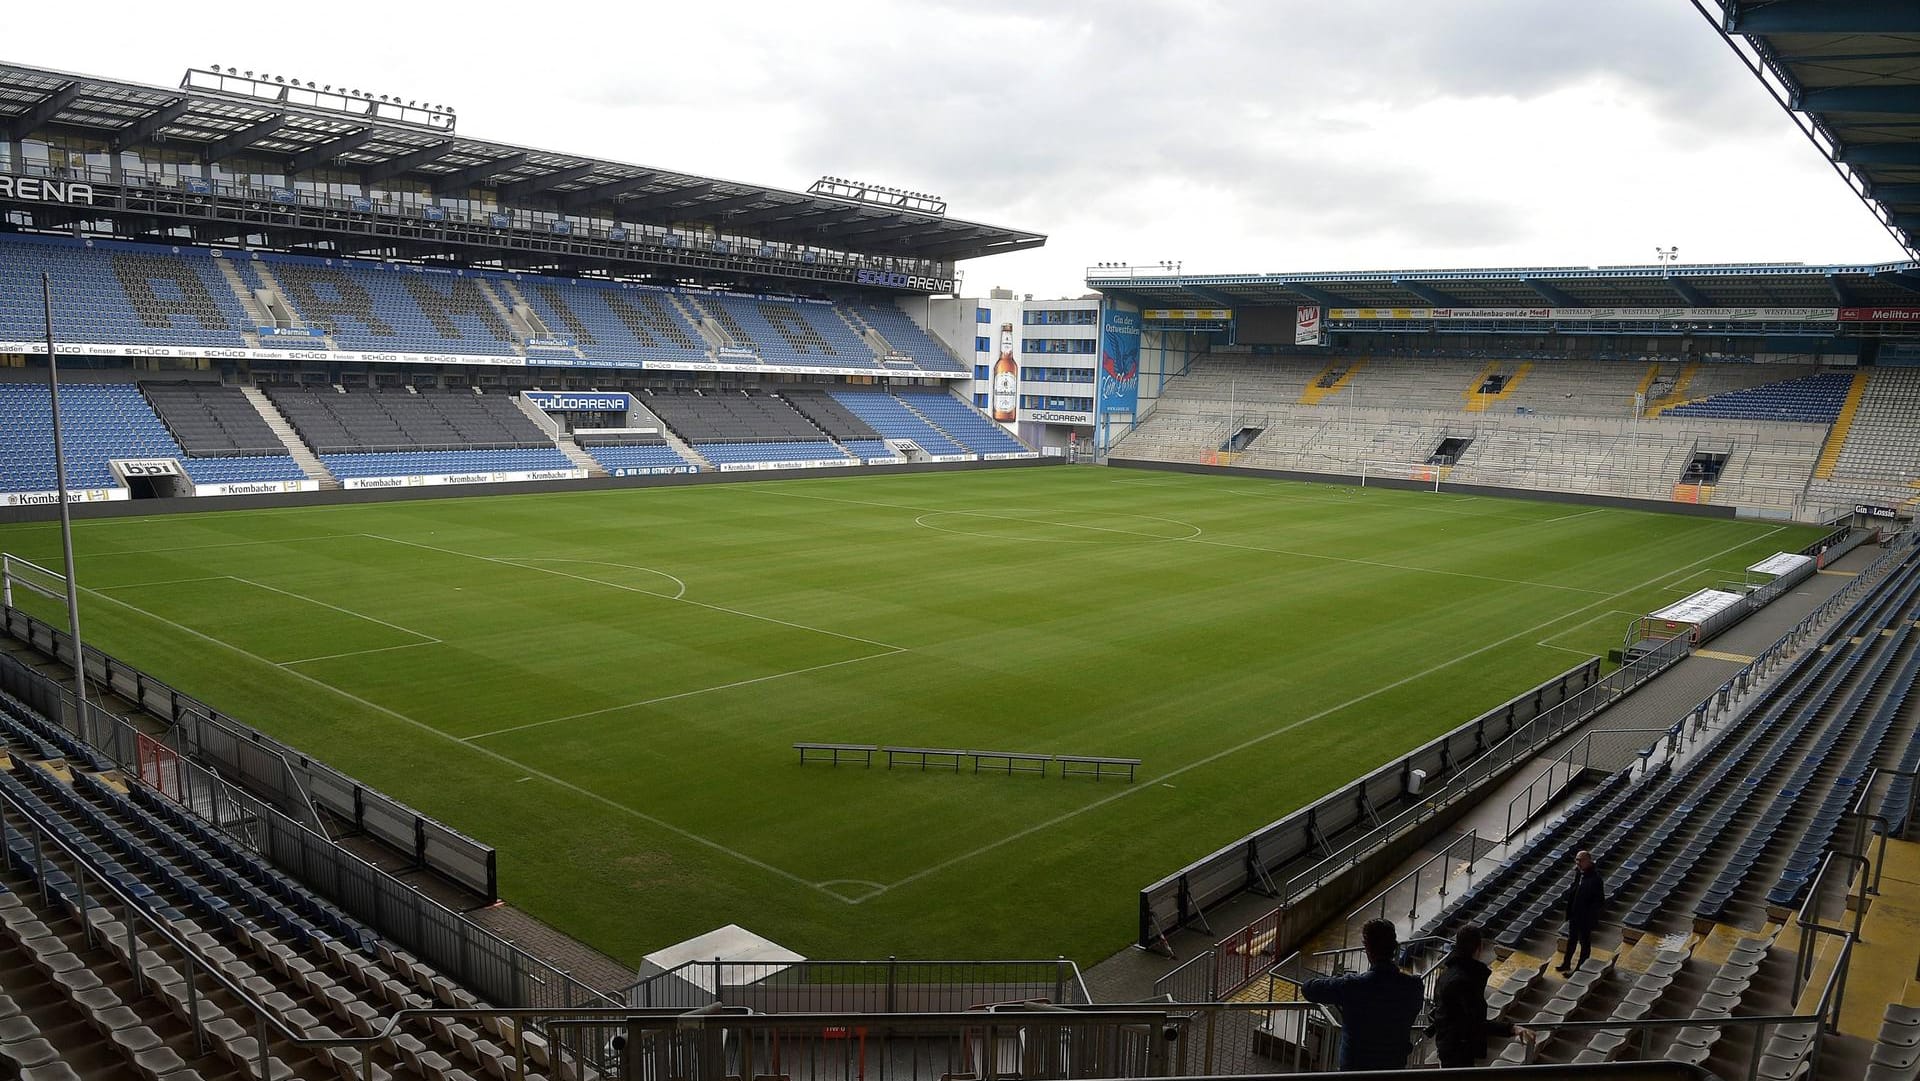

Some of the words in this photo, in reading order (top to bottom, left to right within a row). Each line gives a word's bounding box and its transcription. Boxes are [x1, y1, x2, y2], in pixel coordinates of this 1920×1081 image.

[1872, 310, 1910, 319] Melitta
[32, 344, 81, 354] SCÜCO
[125, 347, 170, 355] SCHÜCO
[204, 349, 246, 358] SCHÜCO
[289, 350, 327, 360] SCHÜCO
[361, 352, 397, 361] SCHÜCO
[423, 354, 457, 363] SCHÜCO
[1031, 411, 1087, 423] SCHÜCOARENA
[124, 463, 171, 476] bpi
[532, 470, 567, 480] Krombacher
[360, 478, 402, 488] Krombacher
[449, 474, 488, 484] Krombacher
[228, 483, 277, 494] Krombacher
[19, 492, 83, 505] Krombaher
[1855, 505, 1868, 514] Gin
[1873, 507, 1895, 518] Lossie
